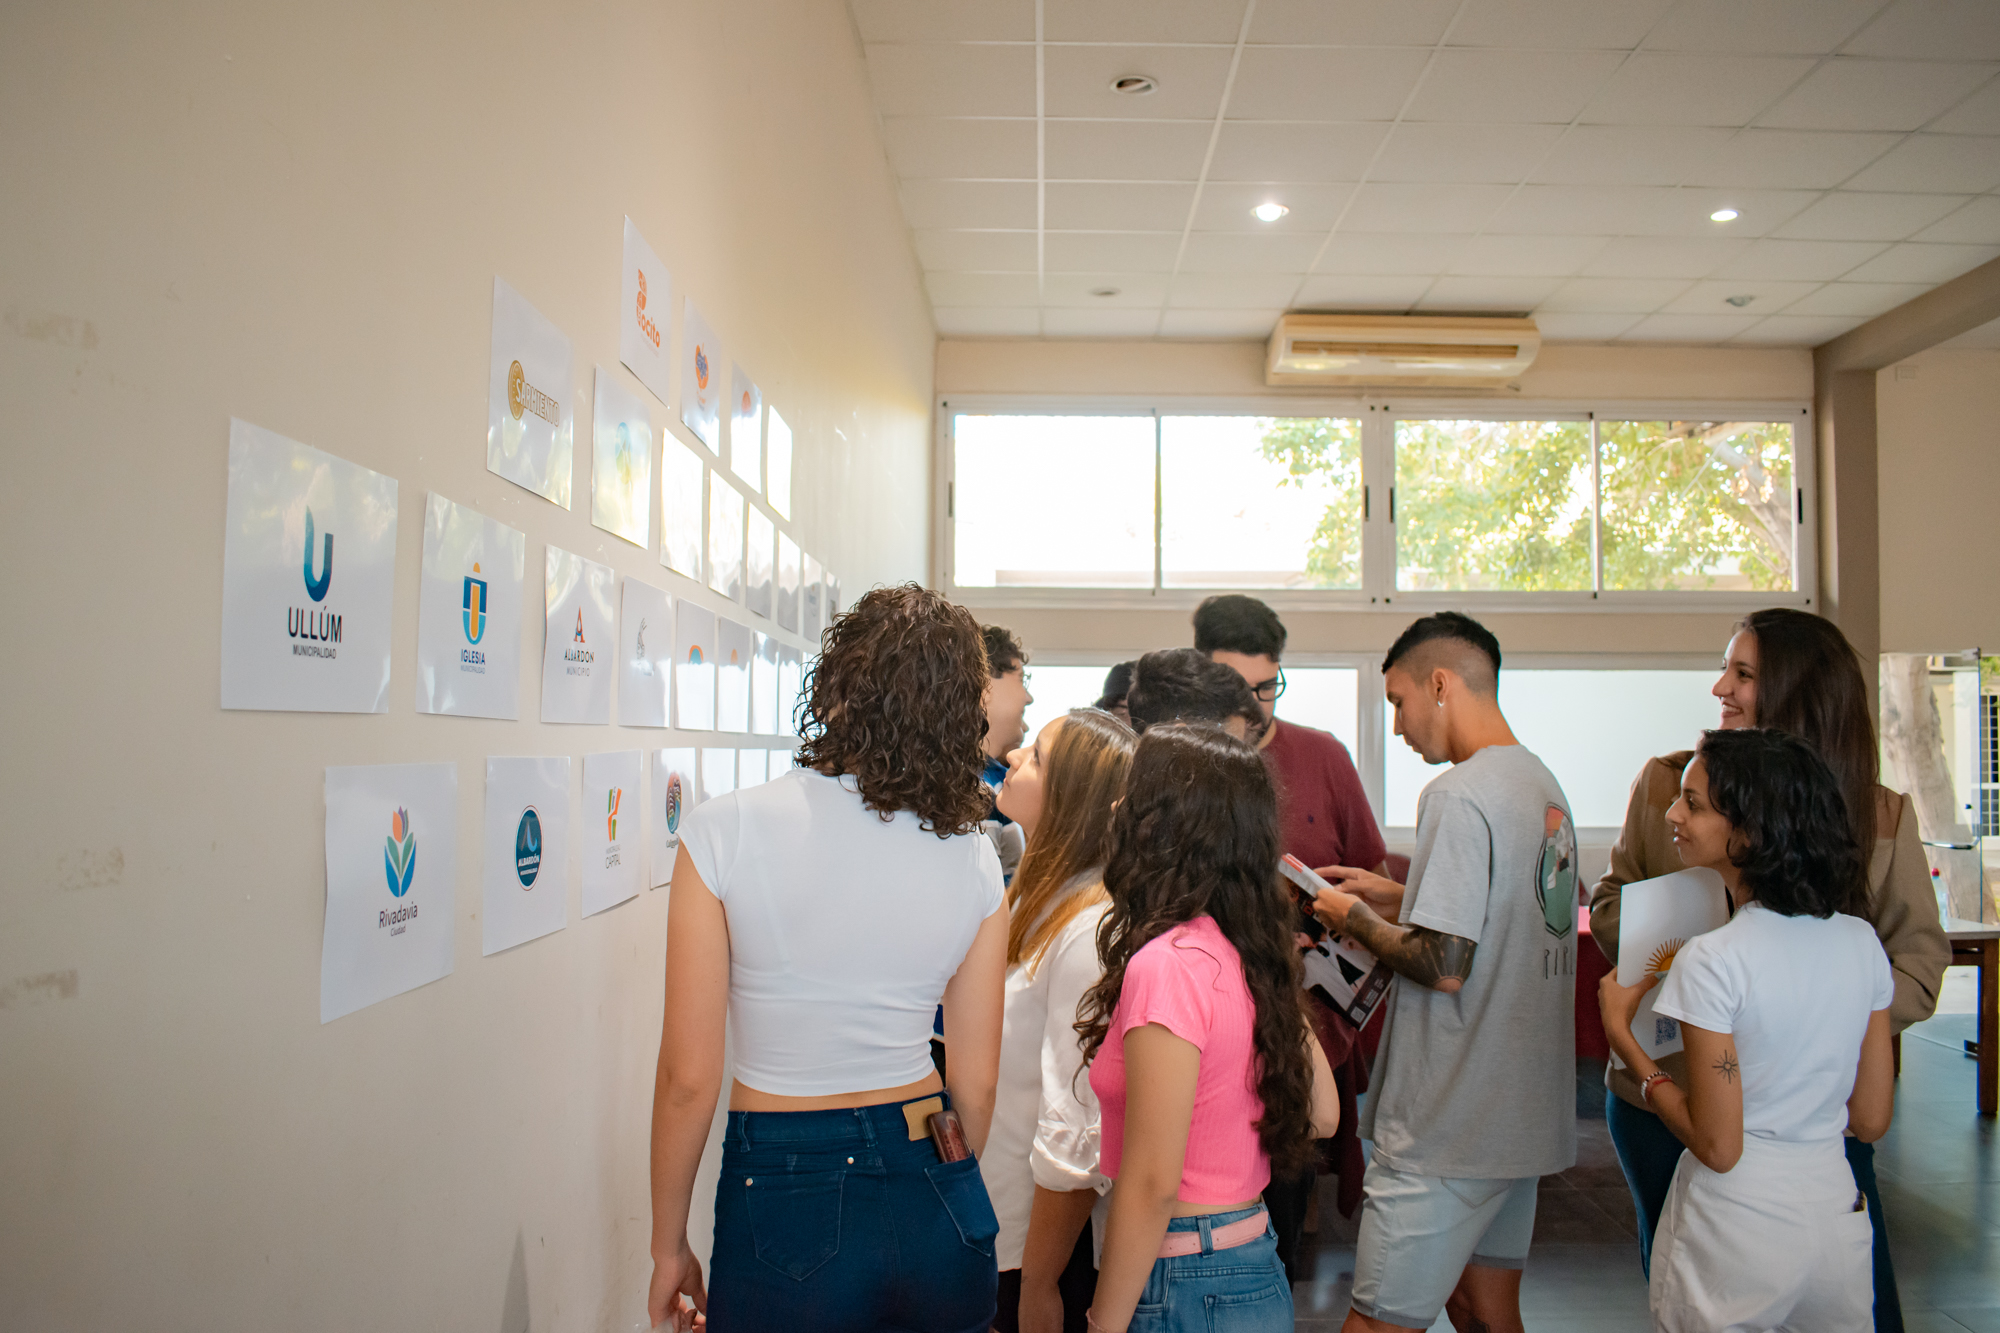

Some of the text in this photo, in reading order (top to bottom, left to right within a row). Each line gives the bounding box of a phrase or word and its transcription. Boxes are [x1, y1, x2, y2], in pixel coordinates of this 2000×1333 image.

[515, 378, 560, 428] SARMIENTO
[288, 605, 343, 644] ULLÚM
[292, 644, 337, 660] MUNICIPALIDAD
[460, 648, 486, 666] IGLESIA
[564, 648, 595, 663] ALBARDÓN
[378, 901, 418, 929] Rivadavia
[390, 923, 407, 937] Ciudad
